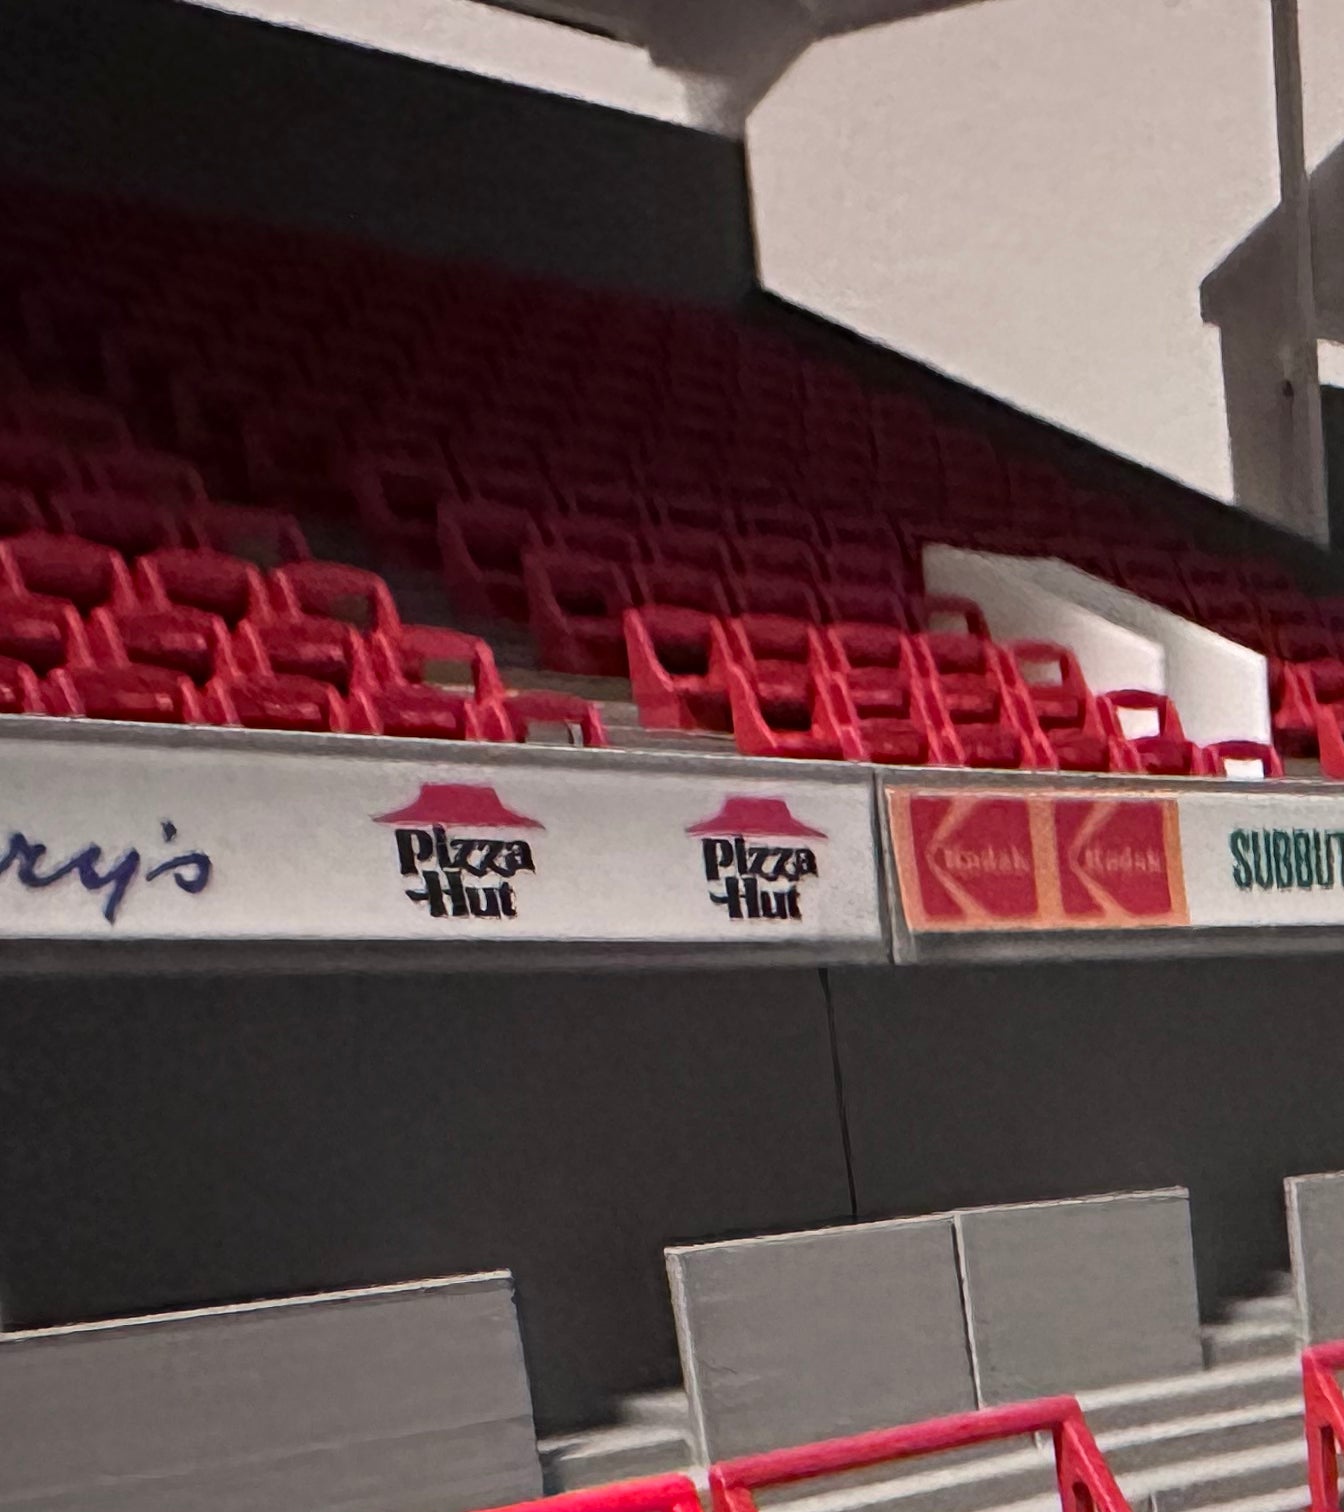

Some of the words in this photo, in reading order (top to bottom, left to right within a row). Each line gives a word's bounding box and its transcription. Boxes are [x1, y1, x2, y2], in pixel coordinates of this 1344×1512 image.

[394, 823, 537, 877] Pizza
[702, 834, 819, 879] Pizza
[405, 868, 518, 918] Hut
[708, 876, 803, 919] Hut
